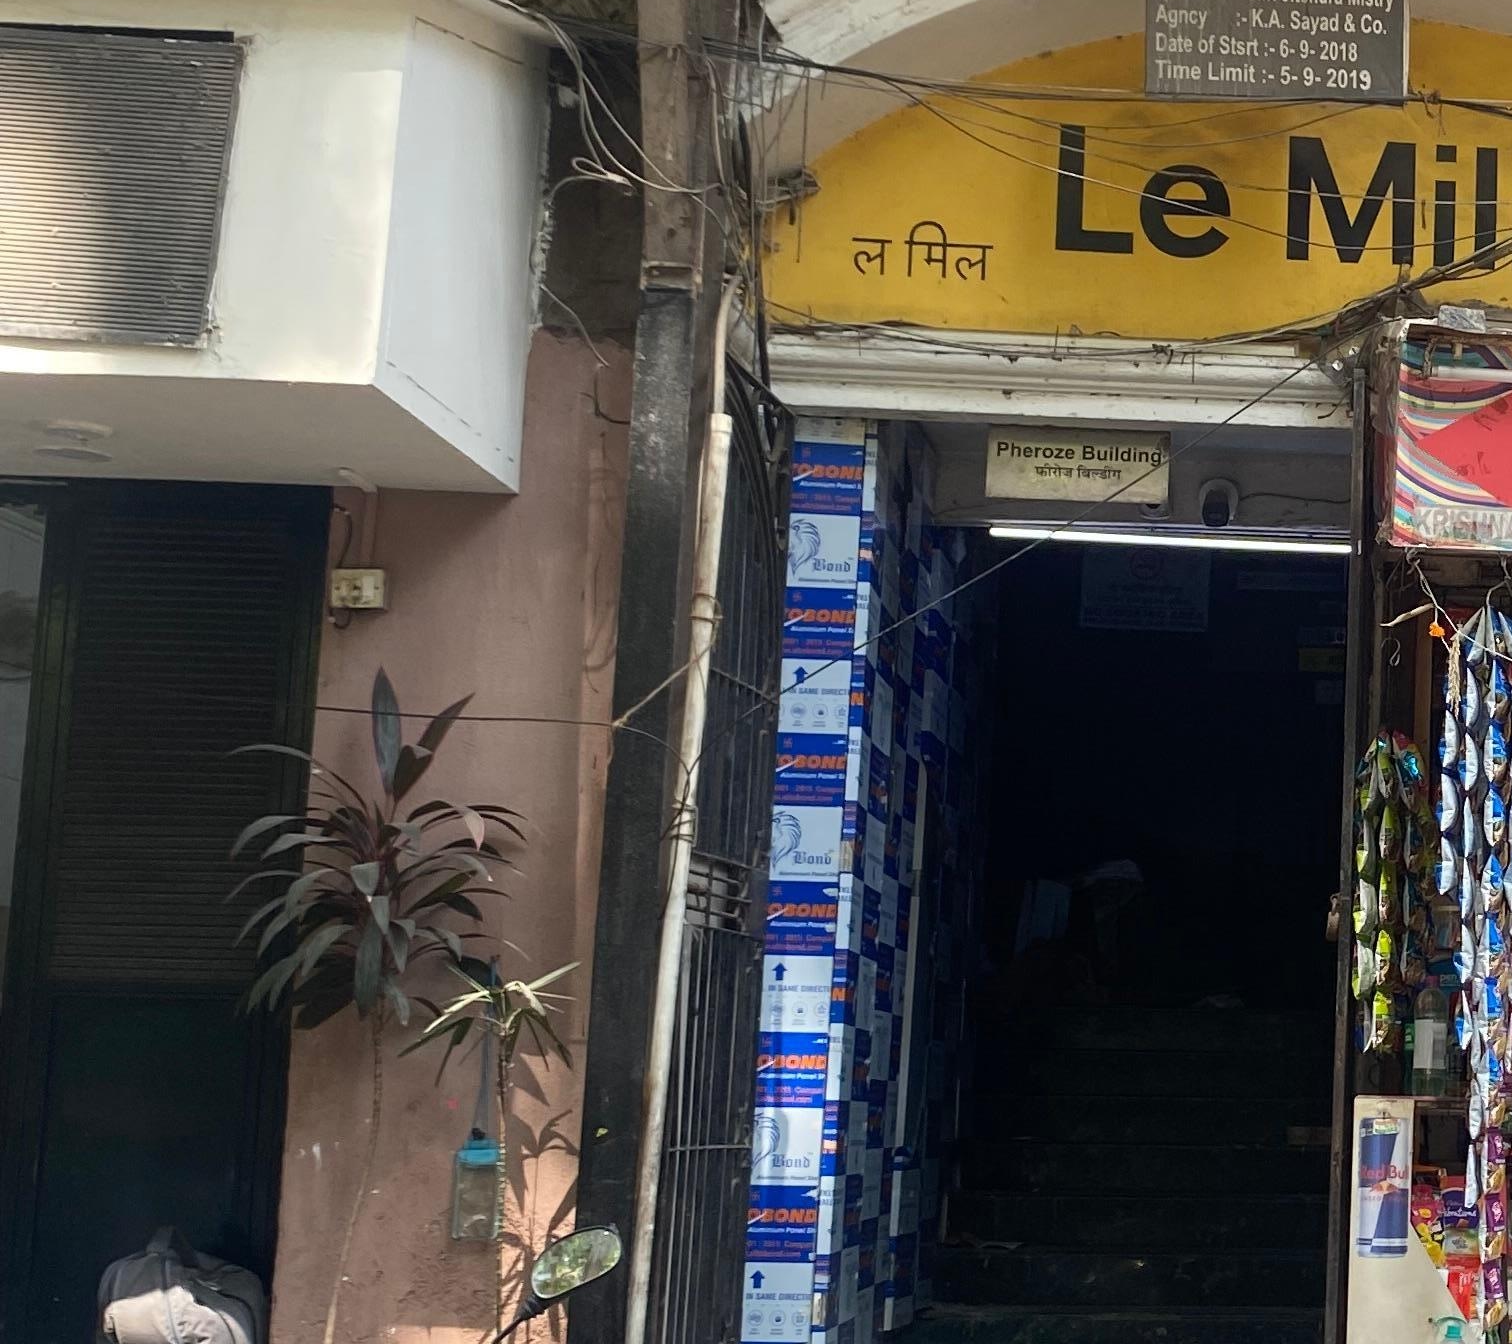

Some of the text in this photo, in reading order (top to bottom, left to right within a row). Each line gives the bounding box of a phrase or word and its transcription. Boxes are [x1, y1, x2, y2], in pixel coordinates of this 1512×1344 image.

[1156, 4, 1208, 29] Agncy
[1252, 8, 1285, 29] K.A.
[1290, 10, 1339, 36] Sayad
[1344, 13, 1356, 34] &
[1360, 14, 1387, 35] Co.
[1155, 32, 1193, 53] Date
[1198, 35, 1215, 53] of
[1319, 41, 1358, 62] 2018
[1155, 60, 1201, 81] Time
[1207, 62, 1256, 83] Limit
[1326, 68, 1373, 90] 2019
[1053, 124, 1232, 259] Le
[904, 221, 993, 281] मिल
[997, 442, 1162, 467] Pheroze Building
